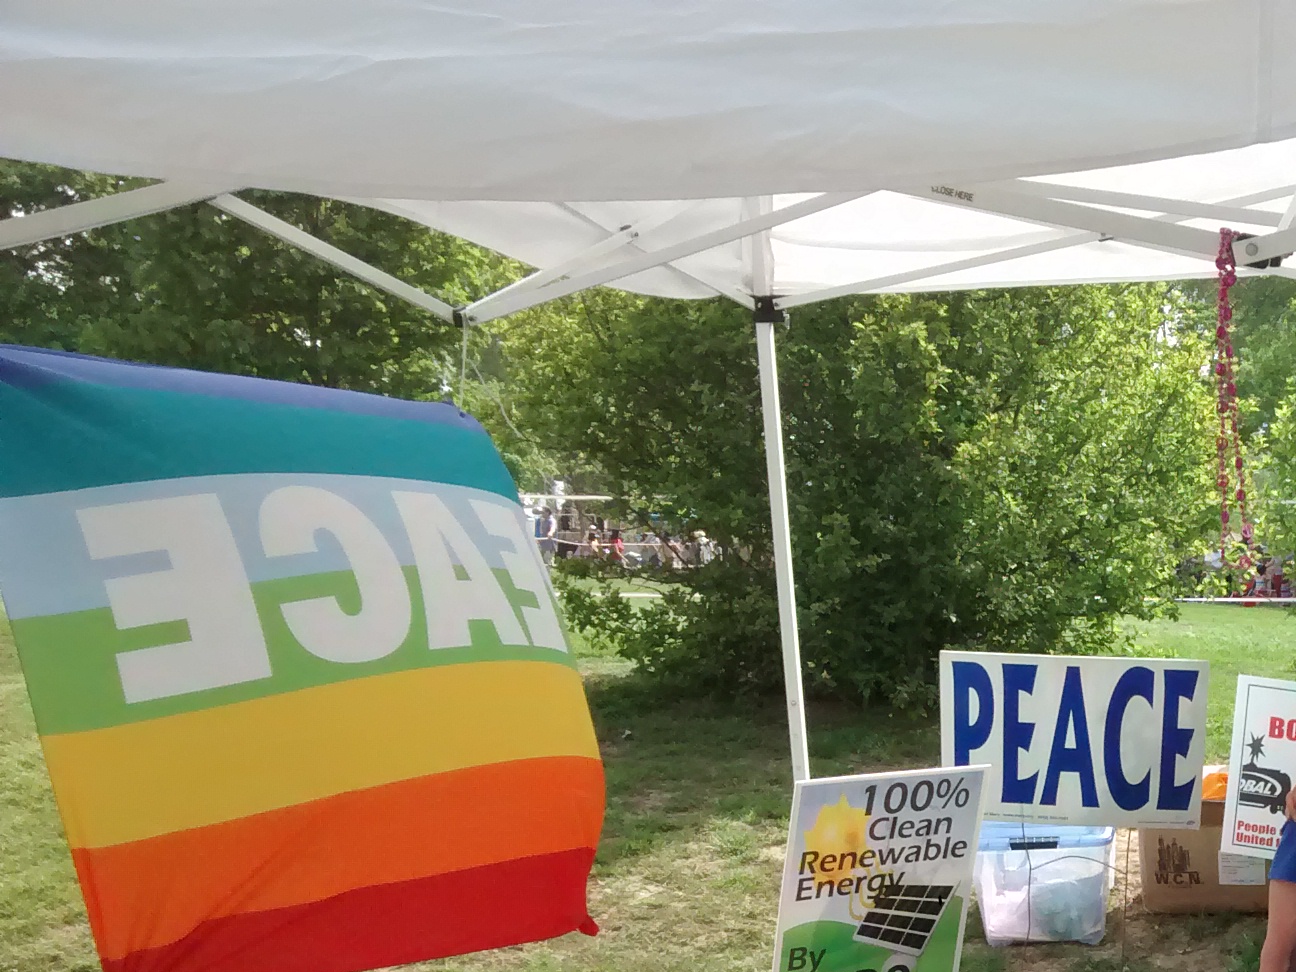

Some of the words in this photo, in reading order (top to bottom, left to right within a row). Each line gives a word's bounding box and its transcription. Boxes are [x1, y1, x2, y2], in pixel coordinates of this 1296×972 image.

[951, 661, 1199, 812] PEACE
[864, 777, 970, 817] 100%
[868, 815, 953, 841] Clean
[1236, 832, 1274, 847] United
[1237, 820, 1277, 836] People
[798, 837, 968, 876] Renewable
[795, 872, 905, 901] Energy
